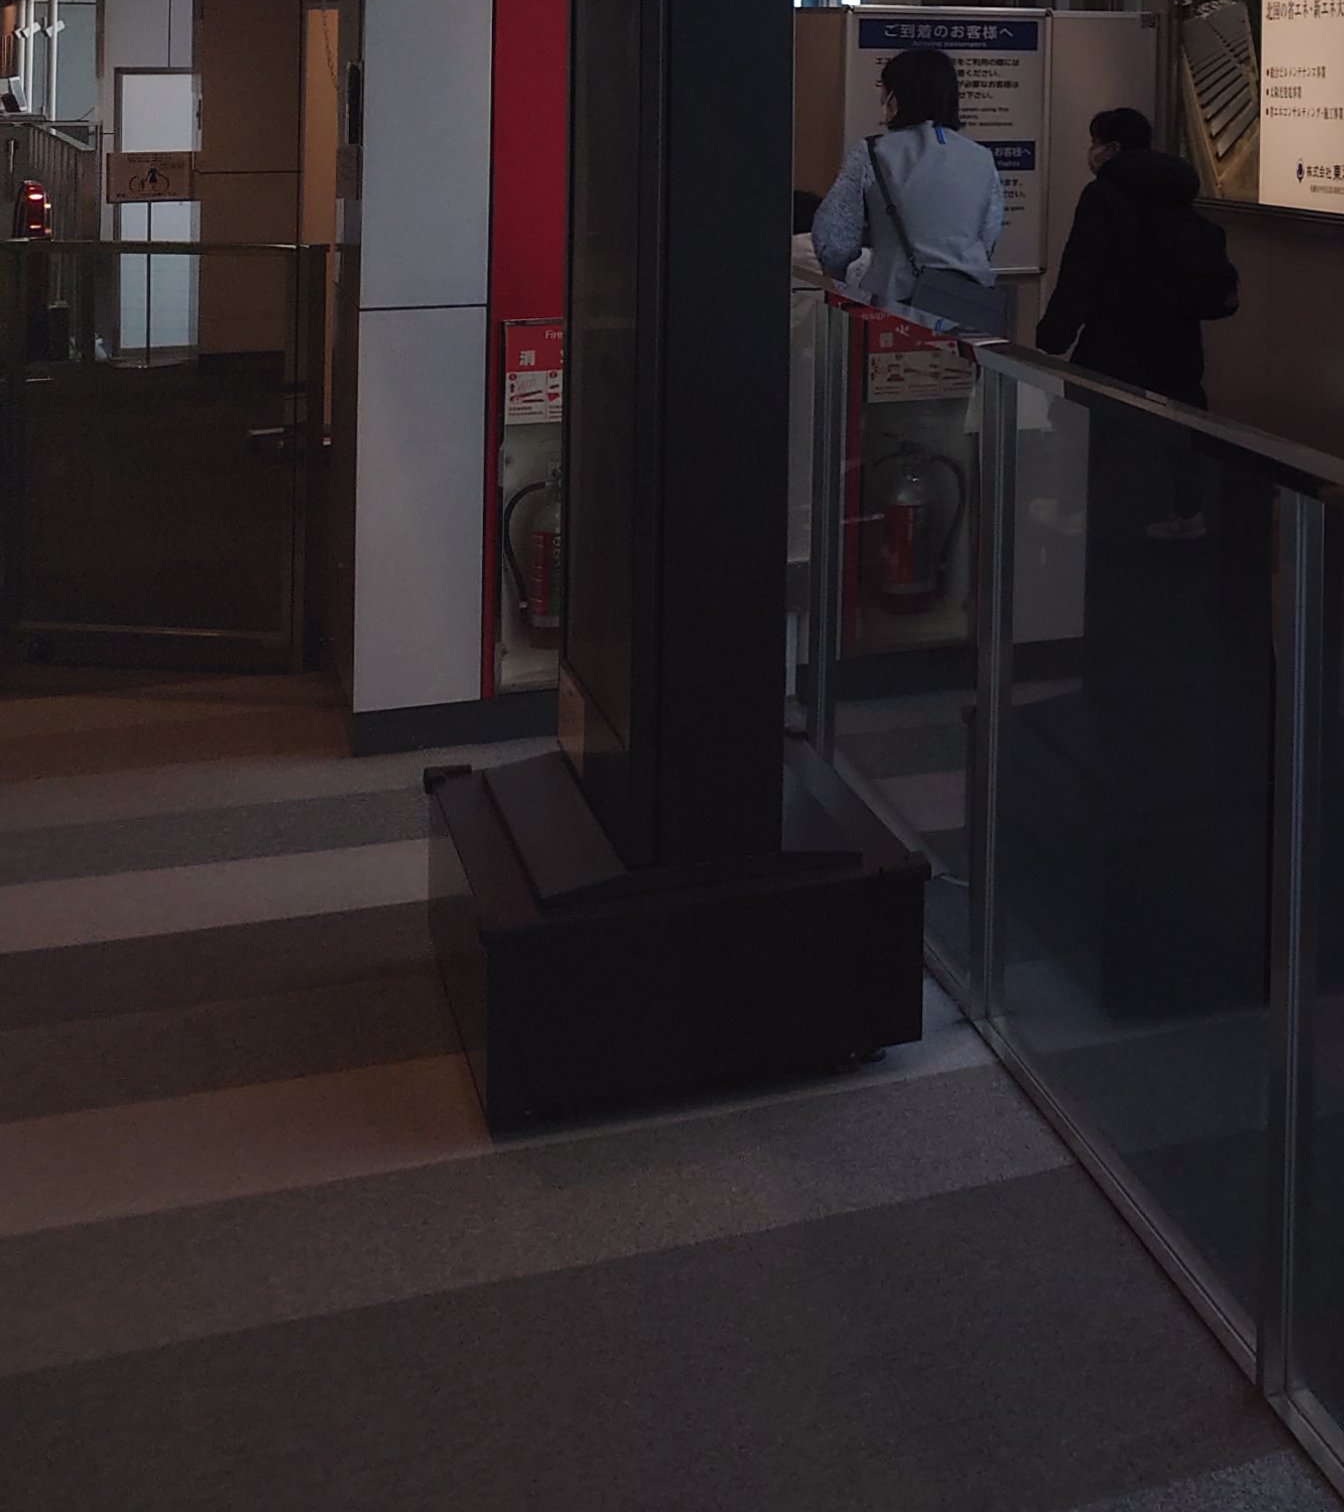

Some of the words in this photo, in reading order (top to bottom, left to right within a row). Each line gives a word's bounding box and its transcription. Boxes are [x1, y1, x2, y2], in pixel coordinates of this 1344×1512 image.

[884, 24, 1014, 40] ご到着のお客様へ
